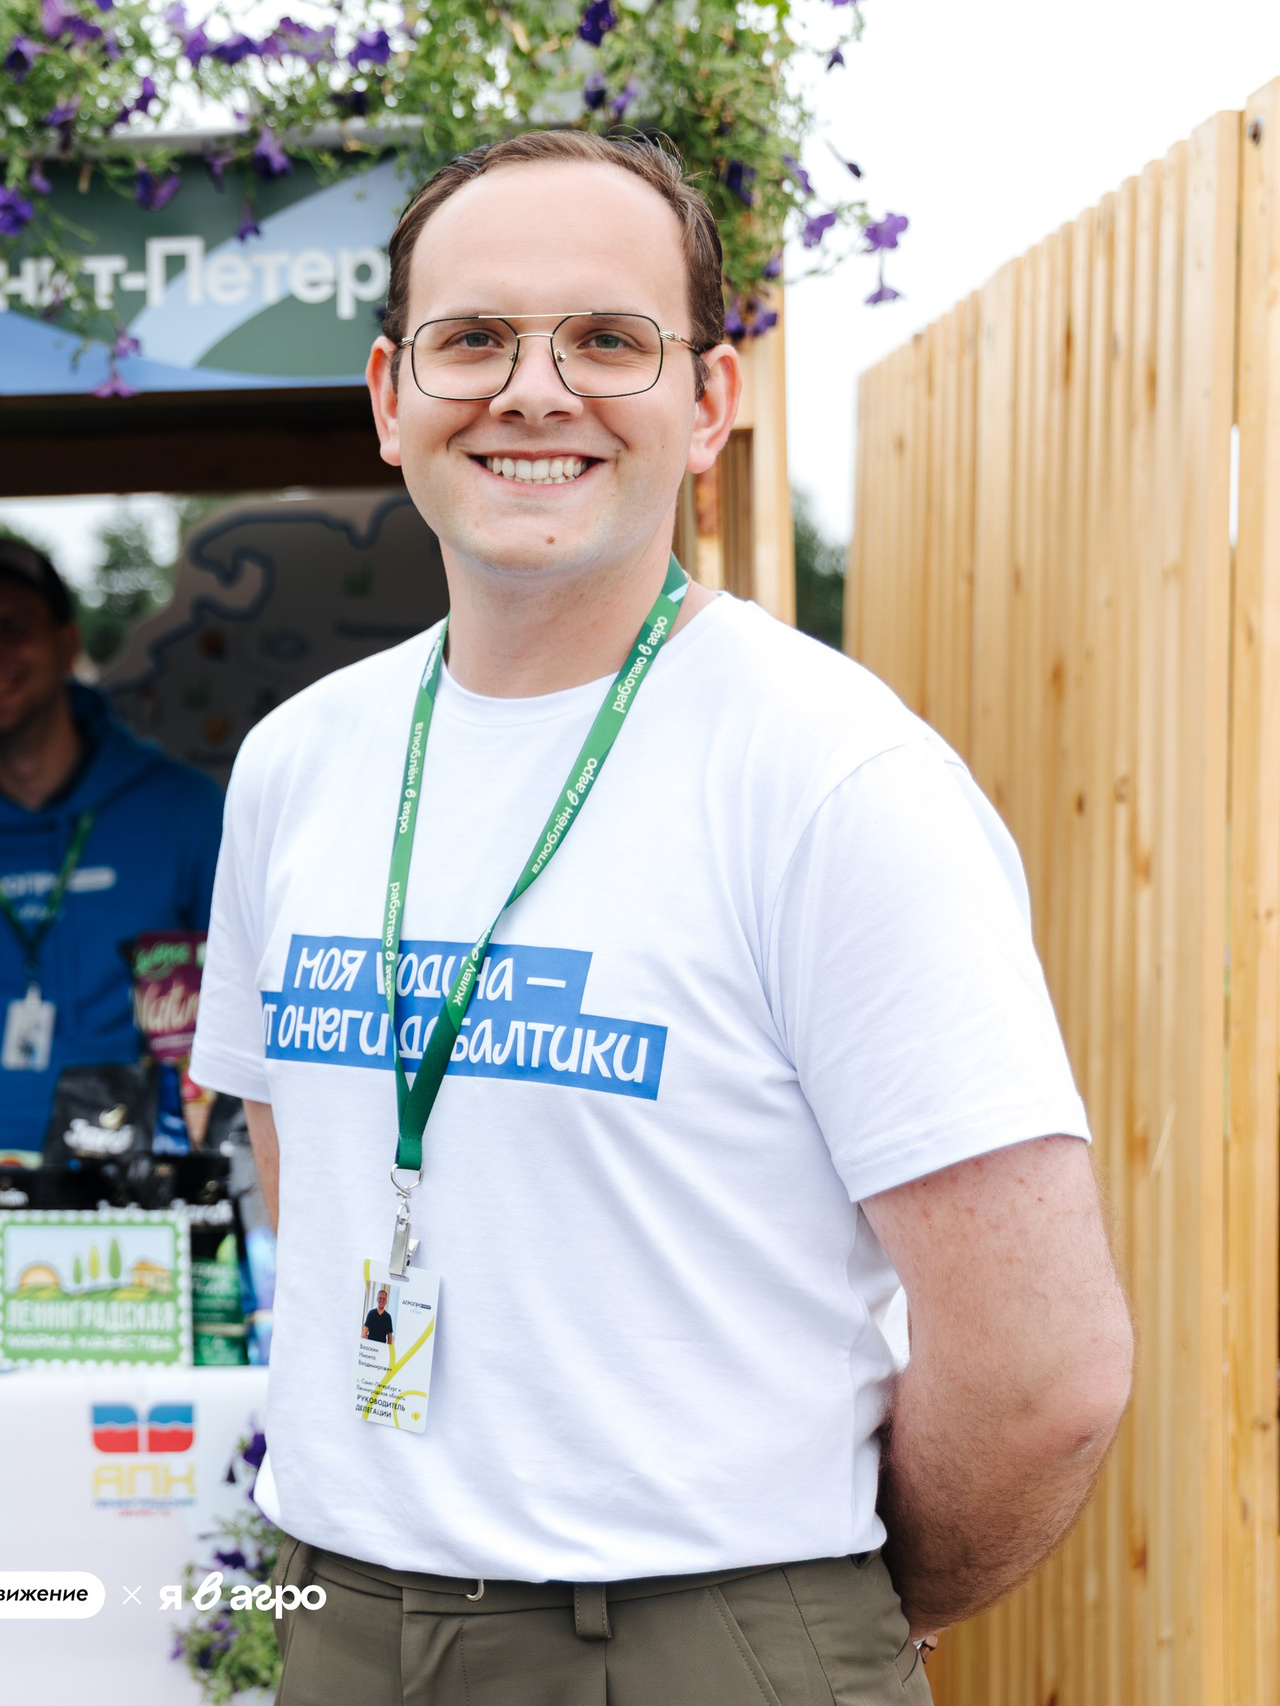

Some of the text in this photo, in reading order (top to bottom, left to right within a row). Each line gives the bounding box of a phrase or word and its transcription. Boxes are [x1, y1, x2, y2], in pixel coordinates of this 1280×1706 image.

[612, 655, 648, 714] работаю
[646, 615, 669, 647] агро
[407, 721, 424, 786] влюблён
[398, 801, 412, 834] агро
[531, 806, 574, 875] влюблён
[574, 757, 598, 795] агро
[385, 881, 401, 948] работаю
[452, 962, 477, 1007] живу
[355, 1404, 392, 1419] ДЕЛЕГАЦИИ
[356, 1394, 406, 1412] РУКОВОДИТЕЛЬ
